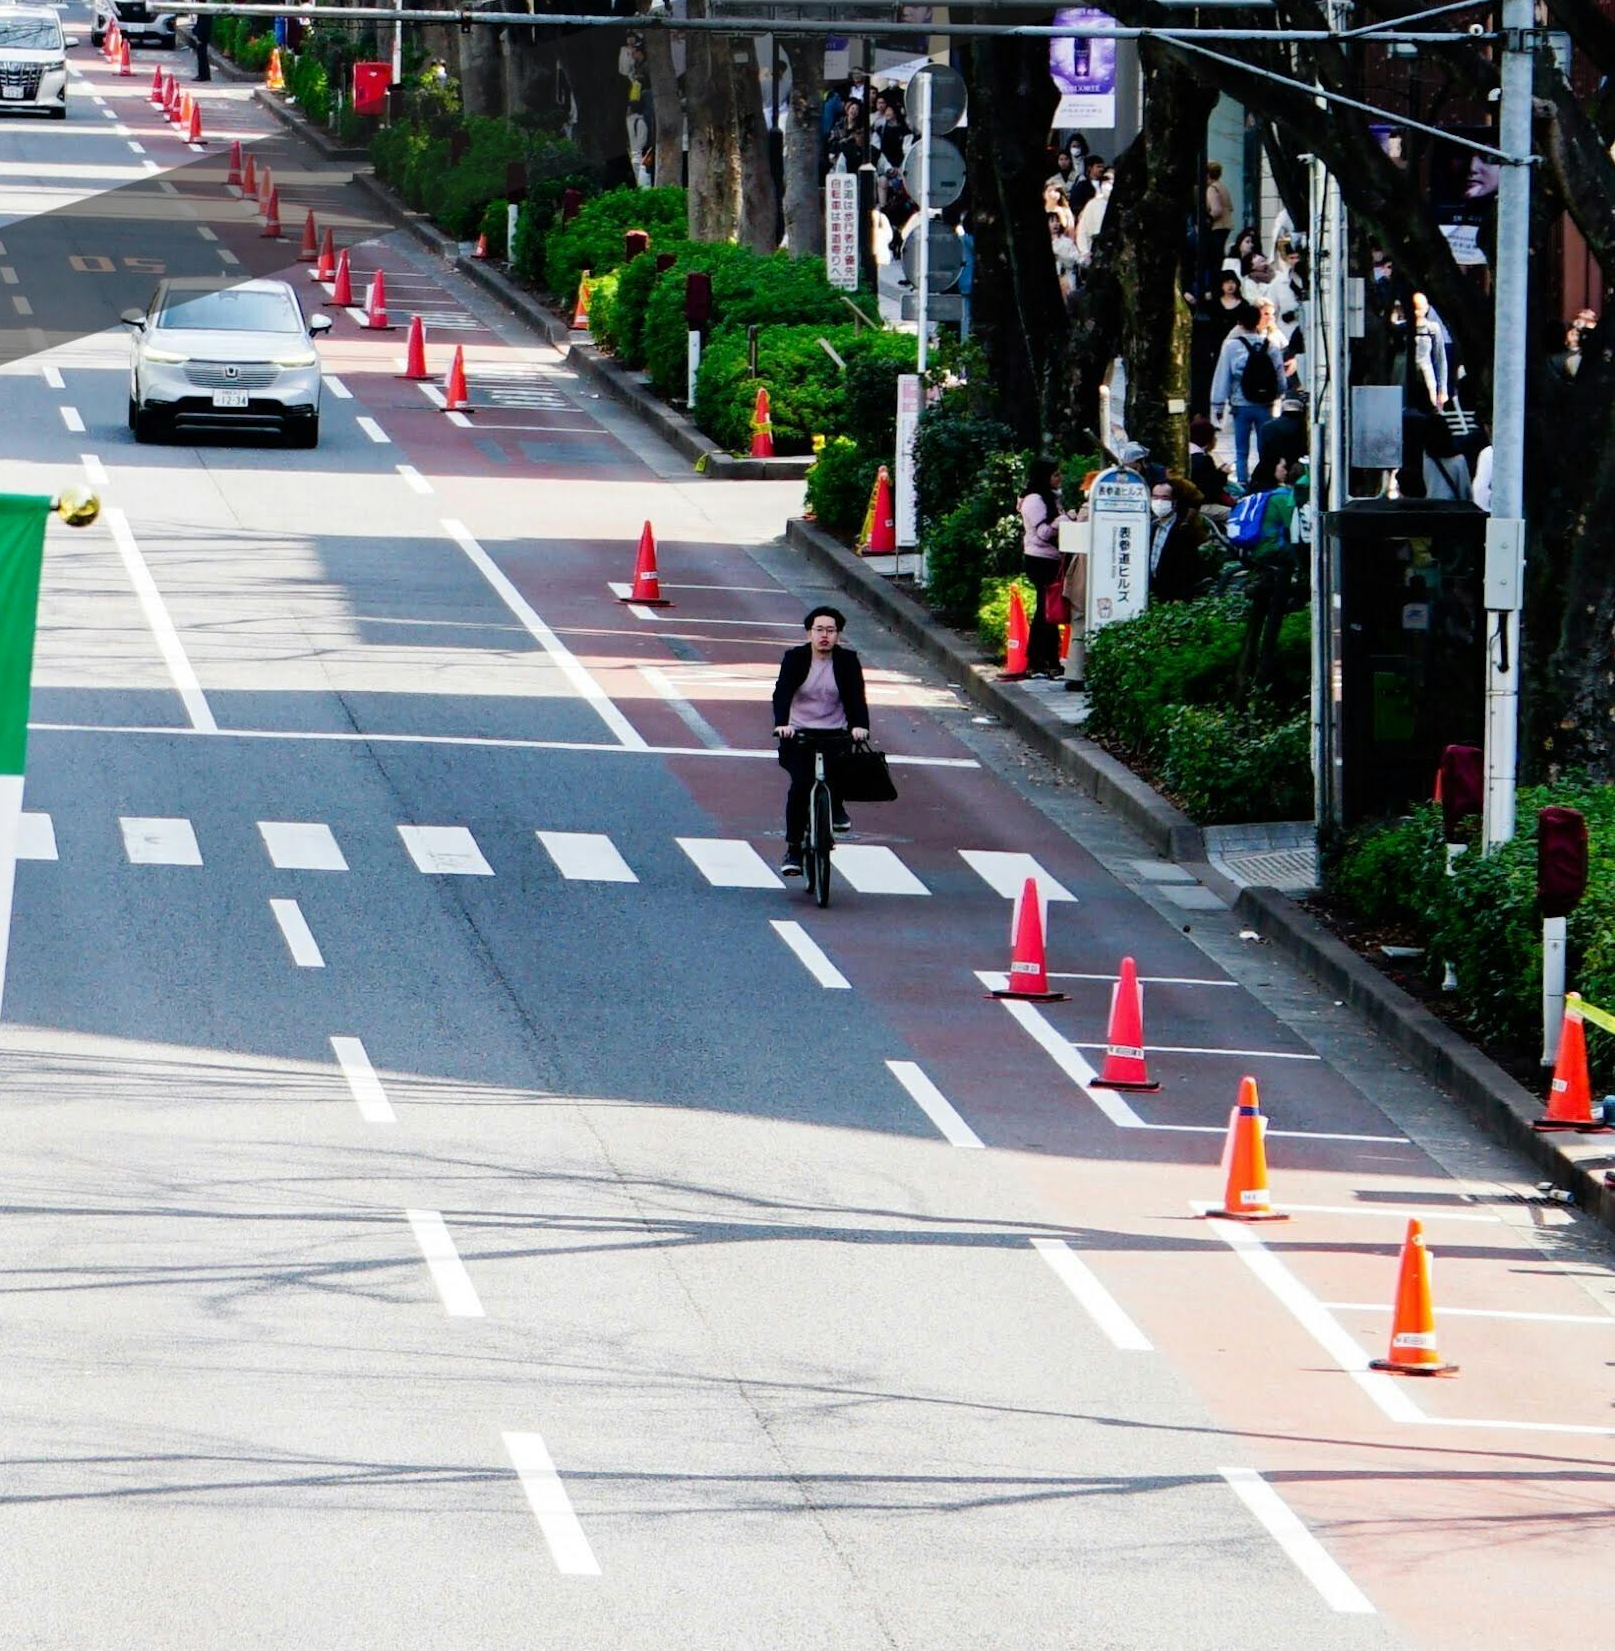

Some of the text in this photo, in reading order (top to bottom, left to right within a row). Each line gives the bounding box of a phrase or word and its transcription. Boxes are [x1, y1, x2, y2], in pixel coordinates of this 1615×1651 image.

[1117, 526, 1133, 603] 表参道ヒルズ
